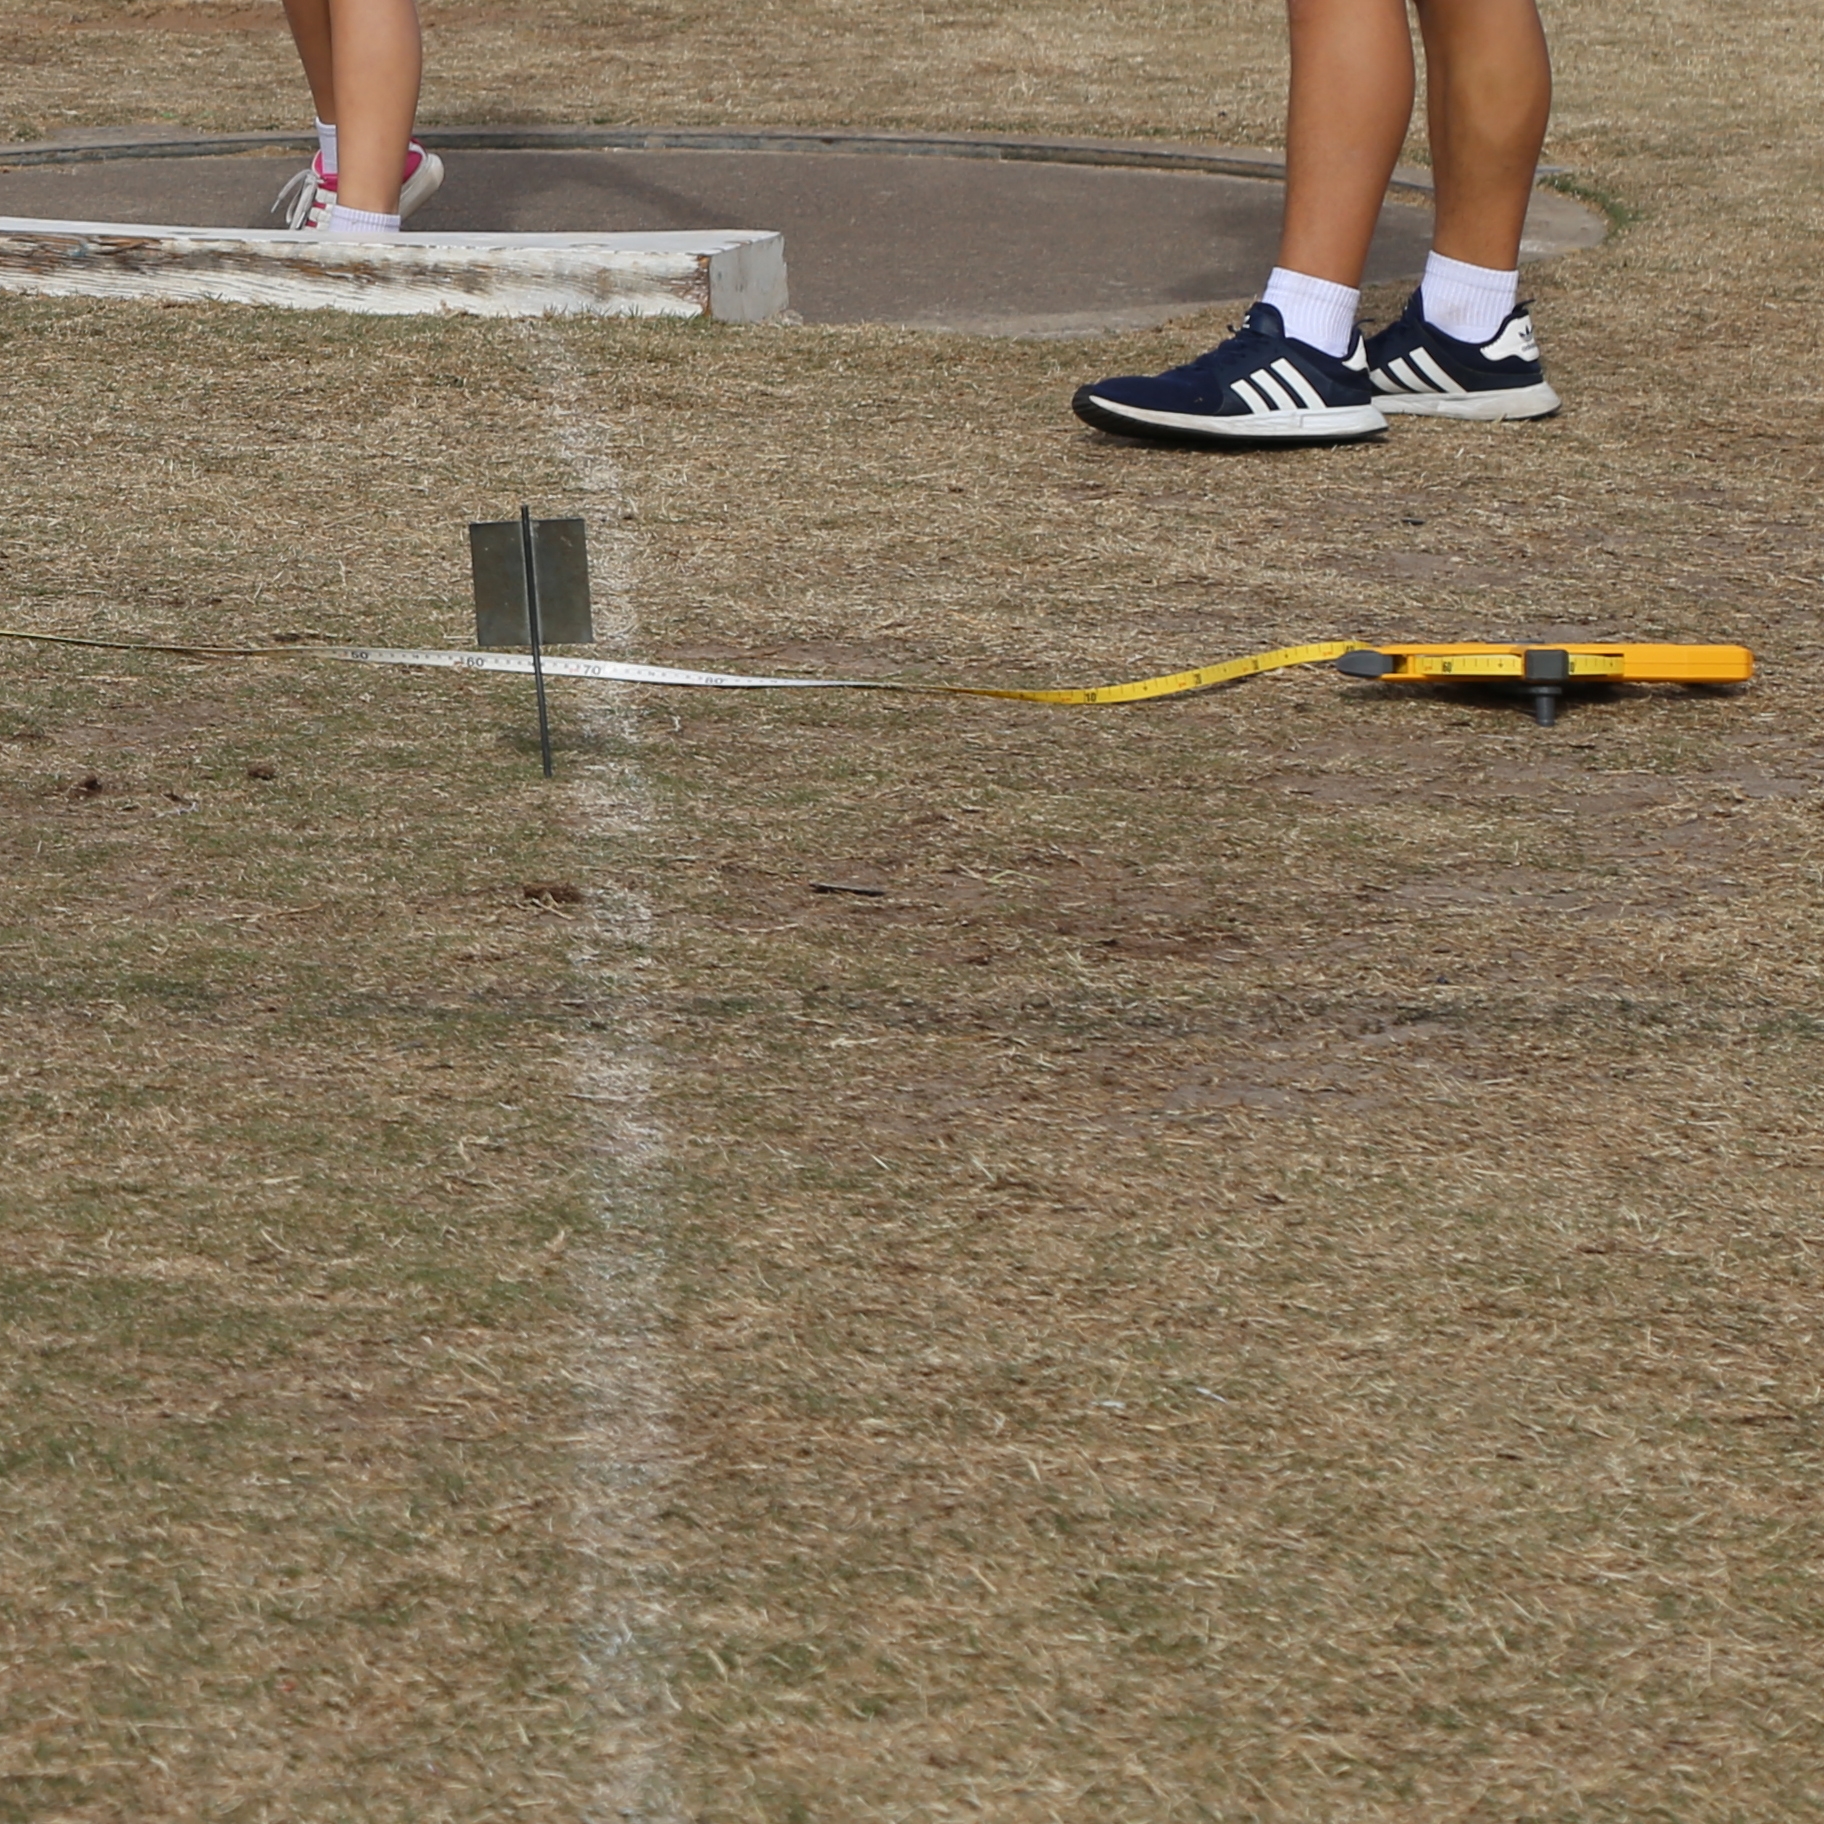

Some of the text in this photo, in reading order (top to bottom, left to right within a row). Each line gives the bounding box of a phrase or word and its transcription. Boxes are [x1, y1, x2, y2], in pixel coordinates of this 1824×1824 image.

[466, 656, 484, 667] 60
[583, 664, 601, 675] 70
[1085, 692, 1097, 702] 10
